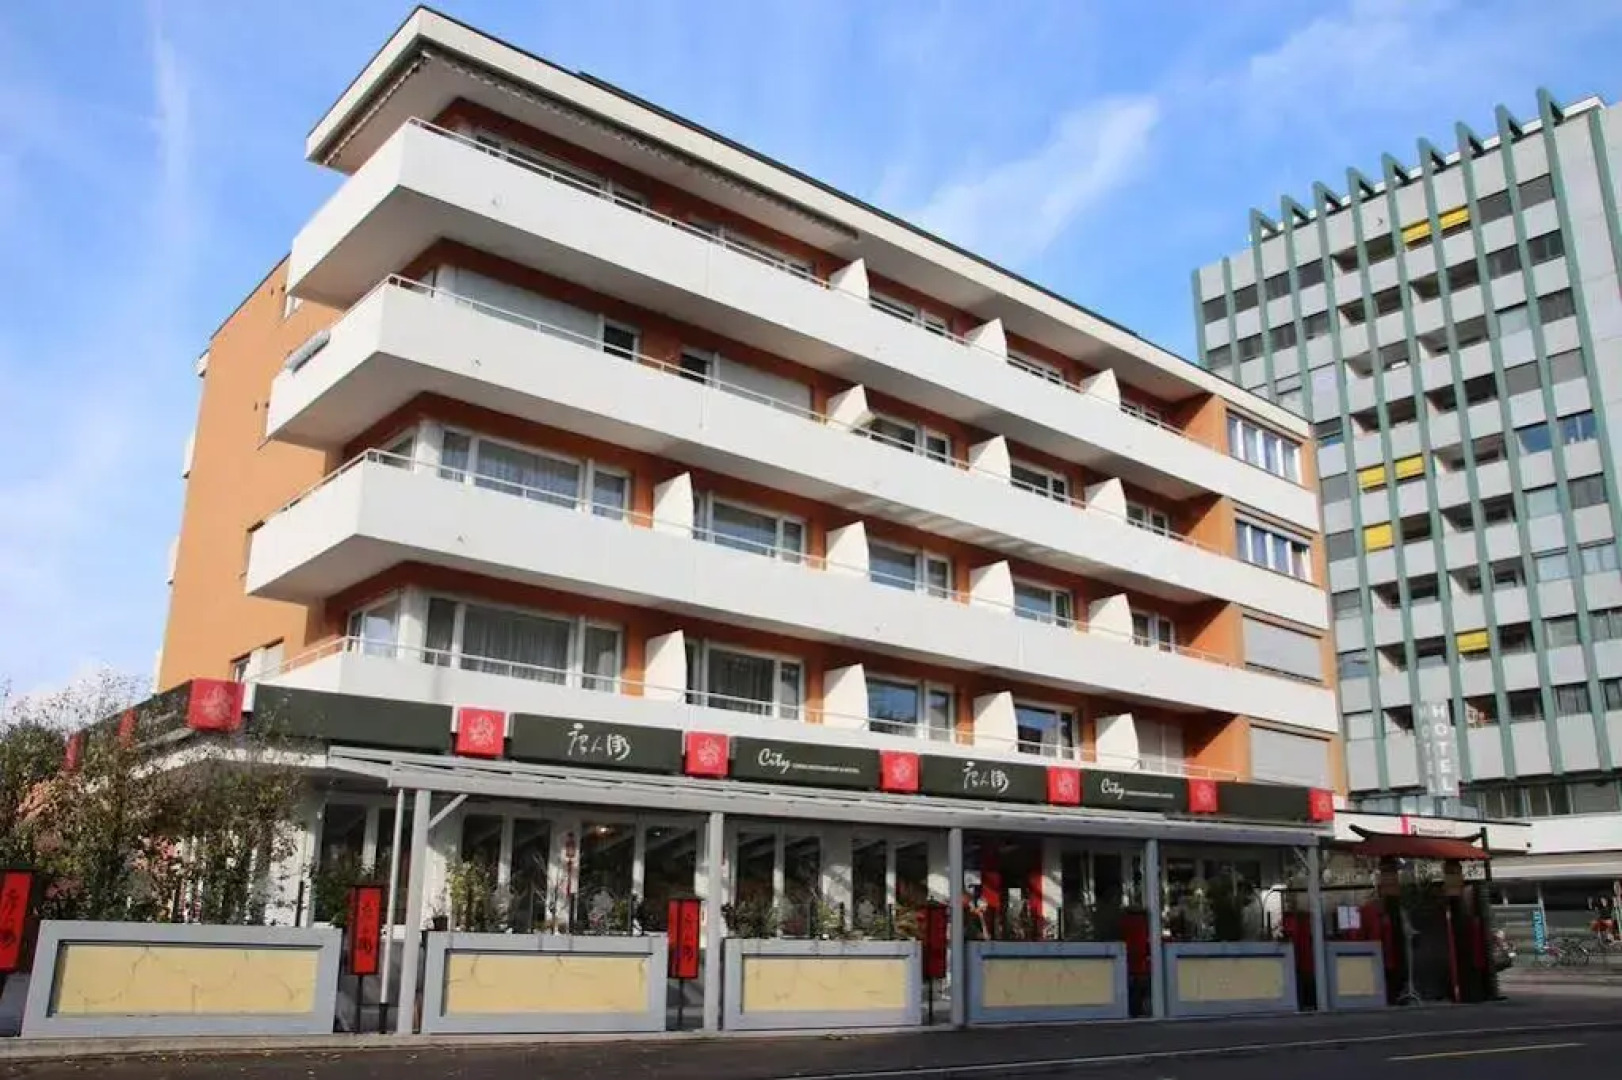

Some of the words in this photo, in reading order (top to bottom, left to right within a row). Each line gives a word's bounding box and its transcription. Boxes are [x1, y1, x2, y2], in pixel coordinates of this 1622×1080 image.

[758, 748, 791, 775] City
[1431, 704, 1455, 792] HOTEL
[1101, 778, 1125, 800] City
